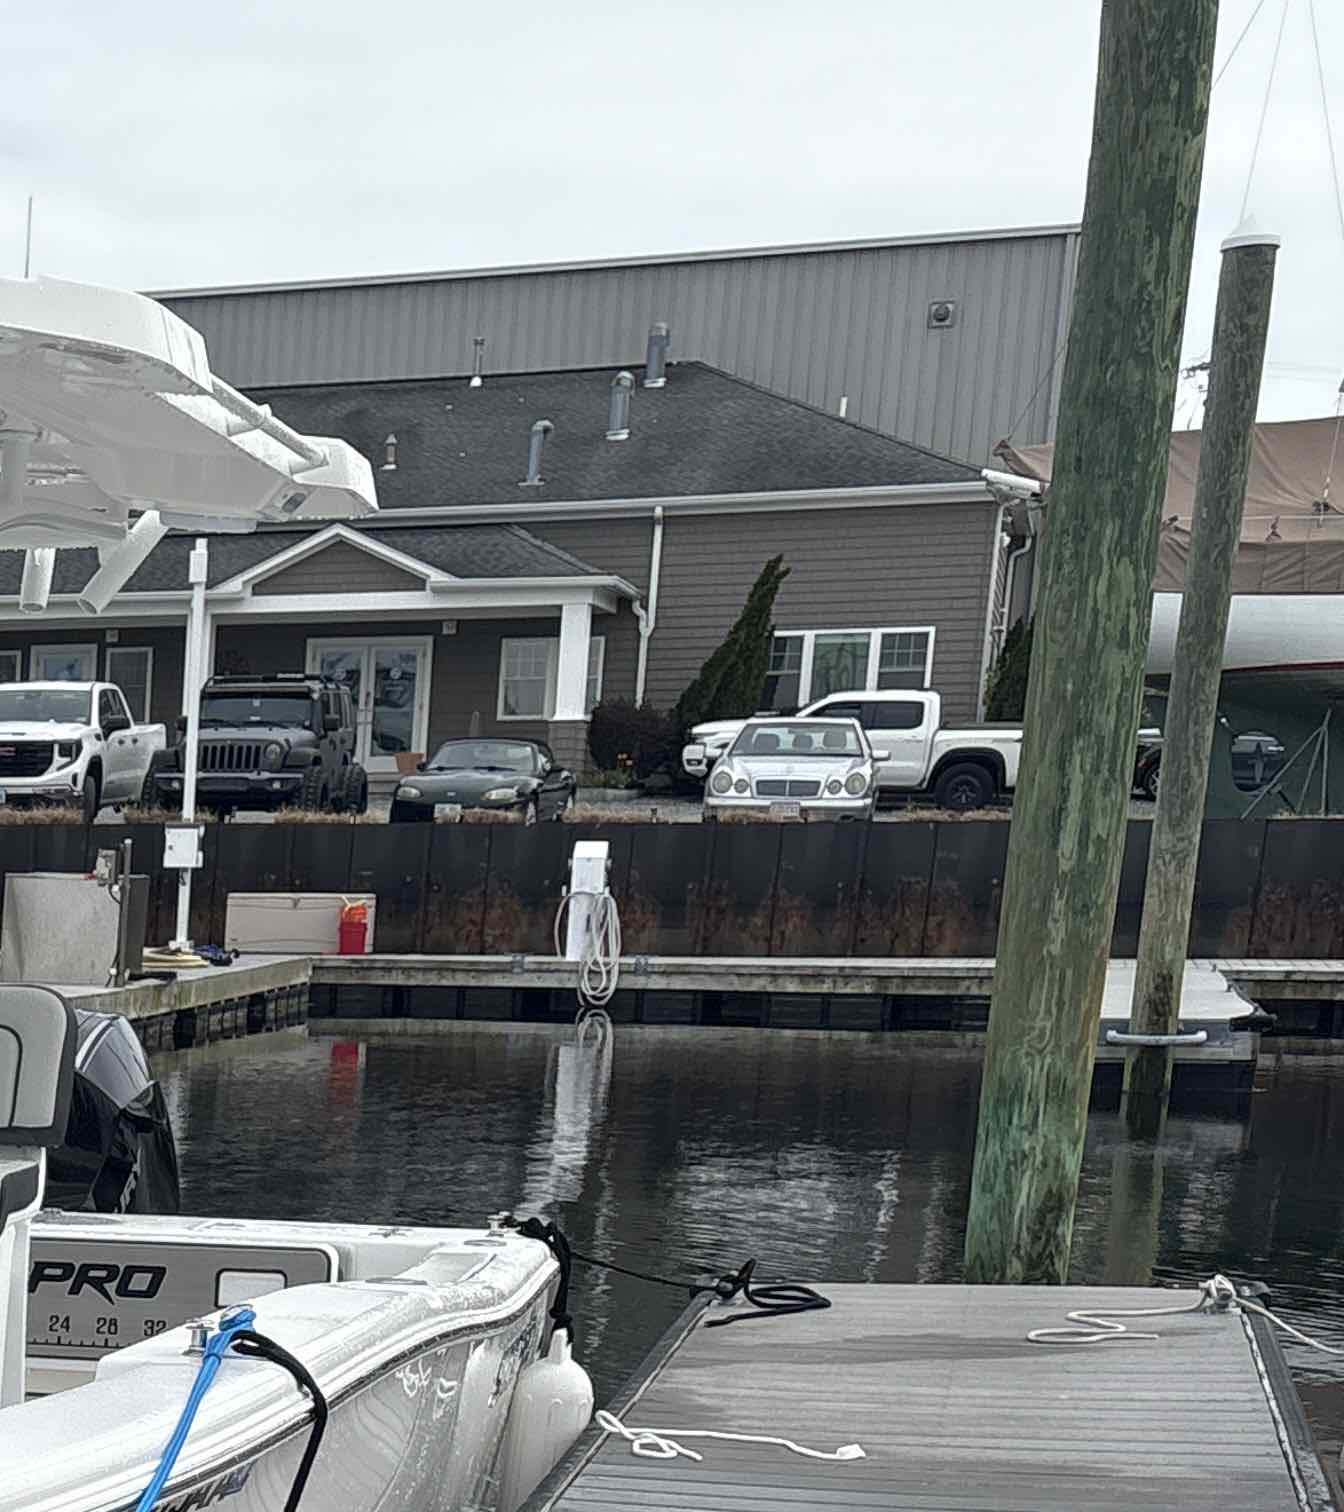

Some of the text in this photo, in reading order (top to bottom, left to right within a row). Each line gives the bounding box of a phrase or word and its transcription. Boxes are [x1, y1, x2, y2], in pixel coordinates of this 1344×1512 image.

[28, 1261, 167, 1306] PRO
[48, 1315, 70, 1332] 24
[96, 1317, 118, 1335] 28
[143, 1319, 166, 1337] 32
